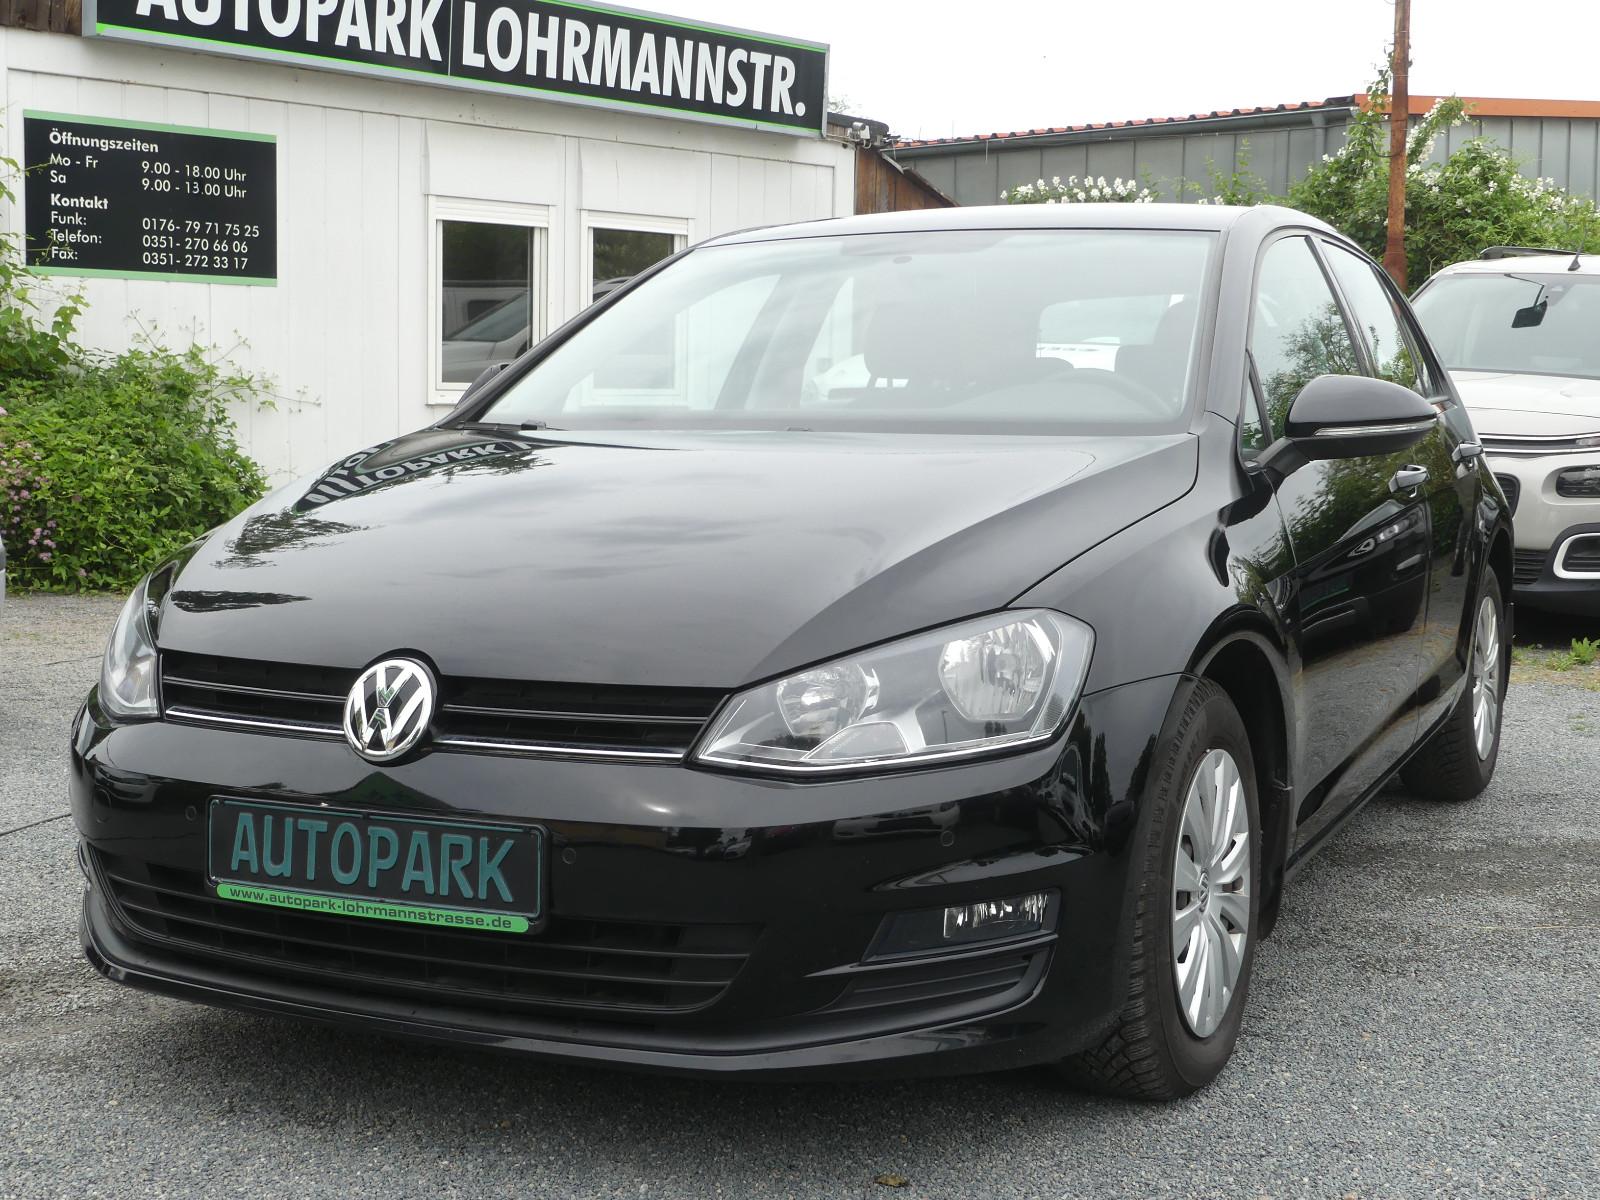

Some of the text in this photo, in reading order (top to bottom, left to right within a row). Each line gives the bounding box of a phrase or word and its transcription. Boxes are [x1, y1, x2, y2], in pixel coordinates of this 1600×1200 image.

[136, 0, 806, 117] OPARK LOHRMANNSTR.
[49, 128, 159, 153] Öffnungszeiten
[49, 152, 71, 167] Mo
[85, 155, 99, 168] Fr
[141, 161, 171, 176] 9.00
[185, 164, 221, 180] 18.00
[224, 168, 247, 182] Uhr
[49, 169, 67, 184] Sa
[141, 178, 171, 193] 9.00
[185, 181, 221, 197] 13.00
[224, 185, 247, 199] Uhr
[50, 192, 109, 210] Kontakt
[50, 210, 260, 238] Funk: 0176- 79 71 75 25
[50, 228, 249, 254] Telefon: 0351- 270 66 06
[51, 246, 249, 270] Fax: 0351- 272 33 17
[230, 812, 514, 903] AUTOPARK
[228, 887, 512, 930] www.autopark-lohrmannstrasse.de
